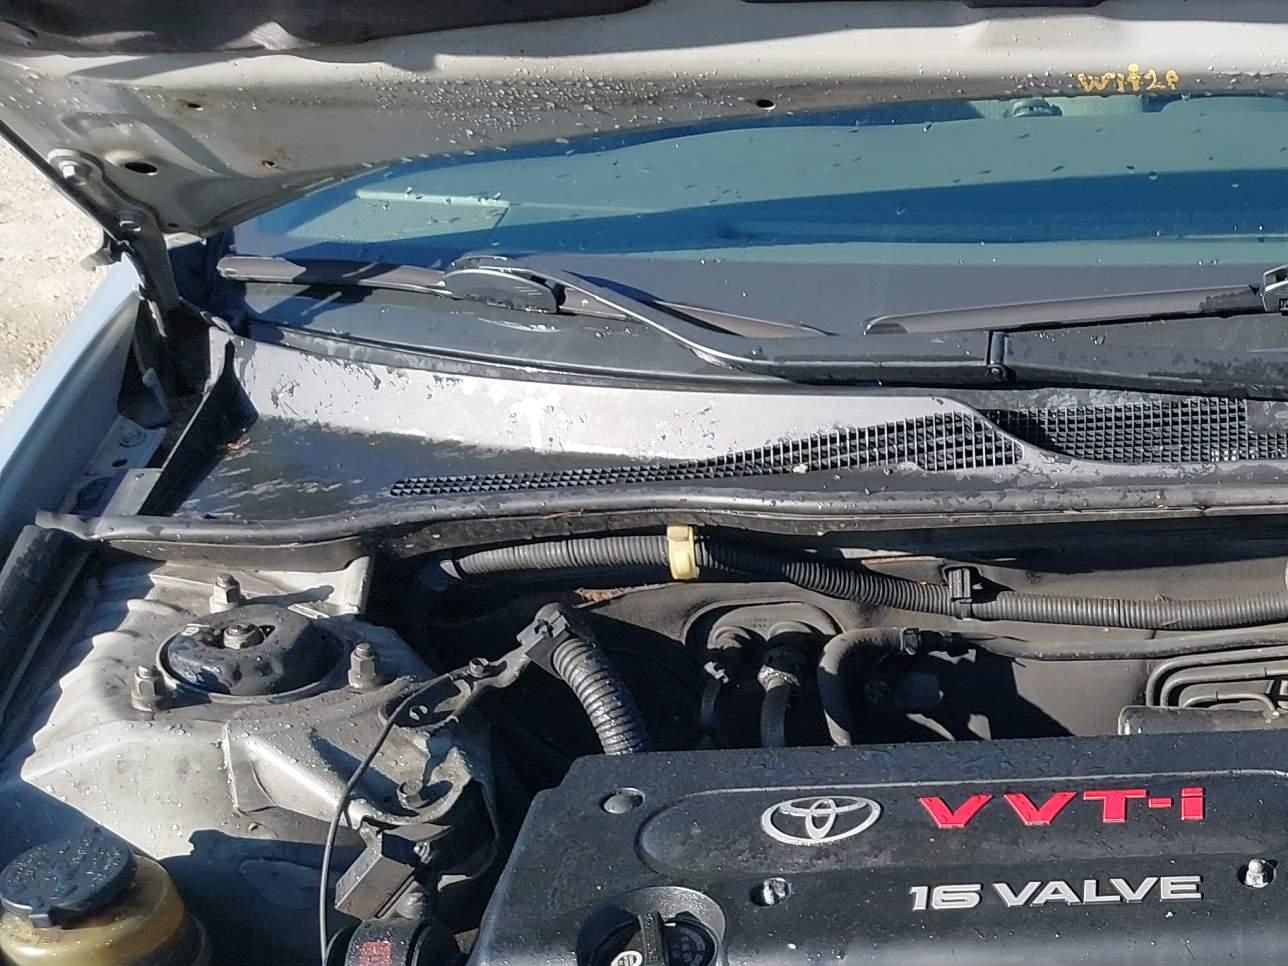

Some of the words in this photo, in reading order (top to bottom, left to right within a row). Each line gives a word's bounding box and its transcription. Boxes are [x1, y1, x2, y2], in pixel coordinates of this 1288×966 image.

[918, 787, 1206, 829] VVT-i
[908, 883, 983, 911] 16
[992, 875, 1203, 908] VALVE
